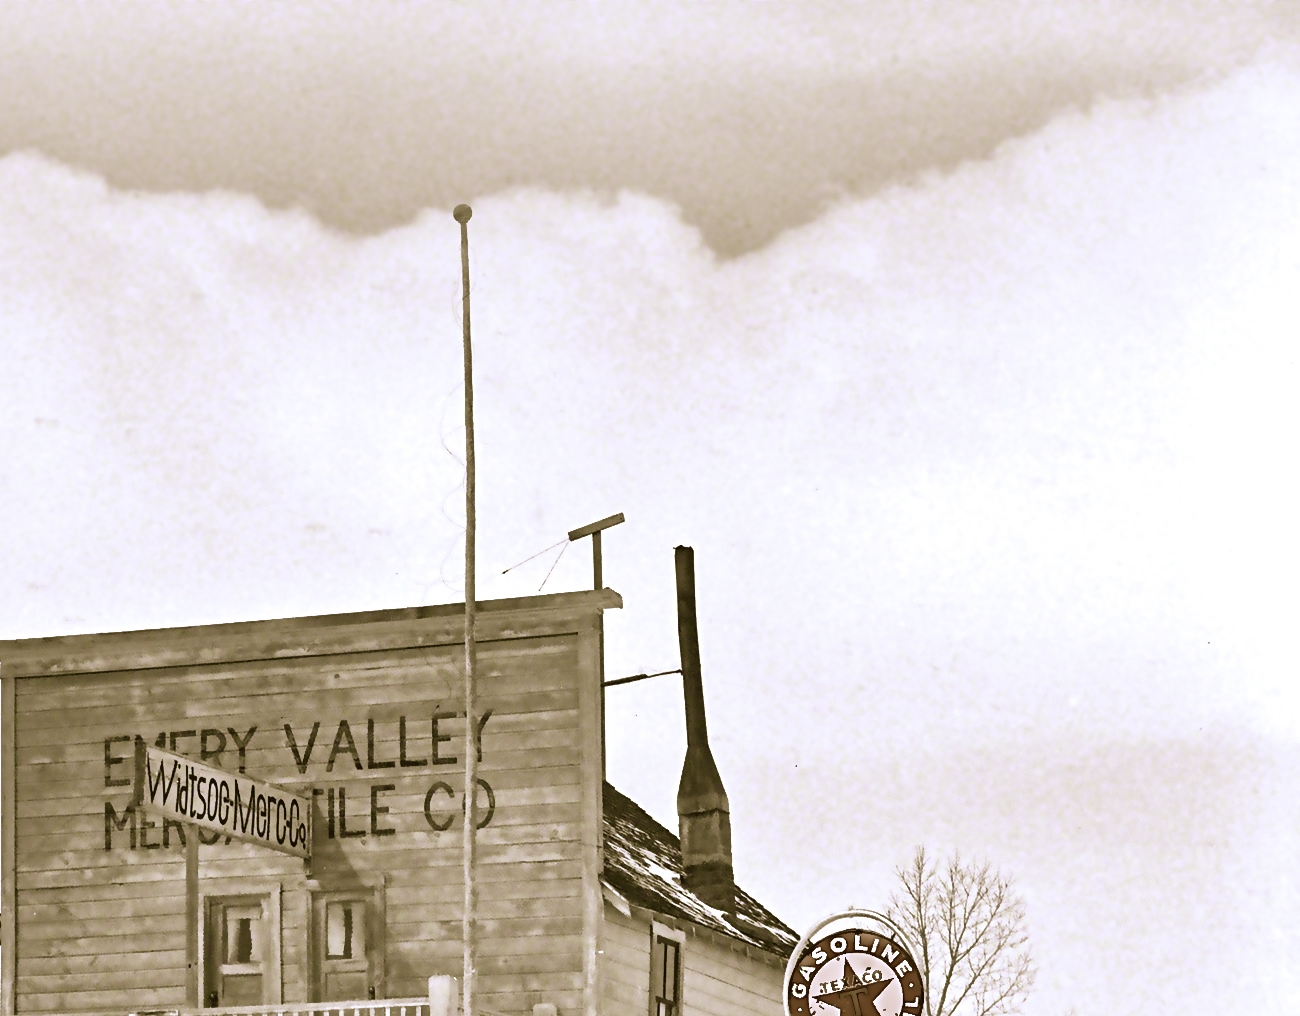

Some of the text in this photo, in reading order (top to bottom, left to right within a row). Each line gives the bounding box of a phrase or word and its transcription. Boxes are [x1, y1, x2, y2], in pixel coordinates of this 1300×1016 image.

[105, 709, 493, 787] ERY VALLEY
[105, 779, 495, 852] MERILE CO
[792, 935, 913, 998] GASOLINE
[820, 970, 883, 993] TEXACO
